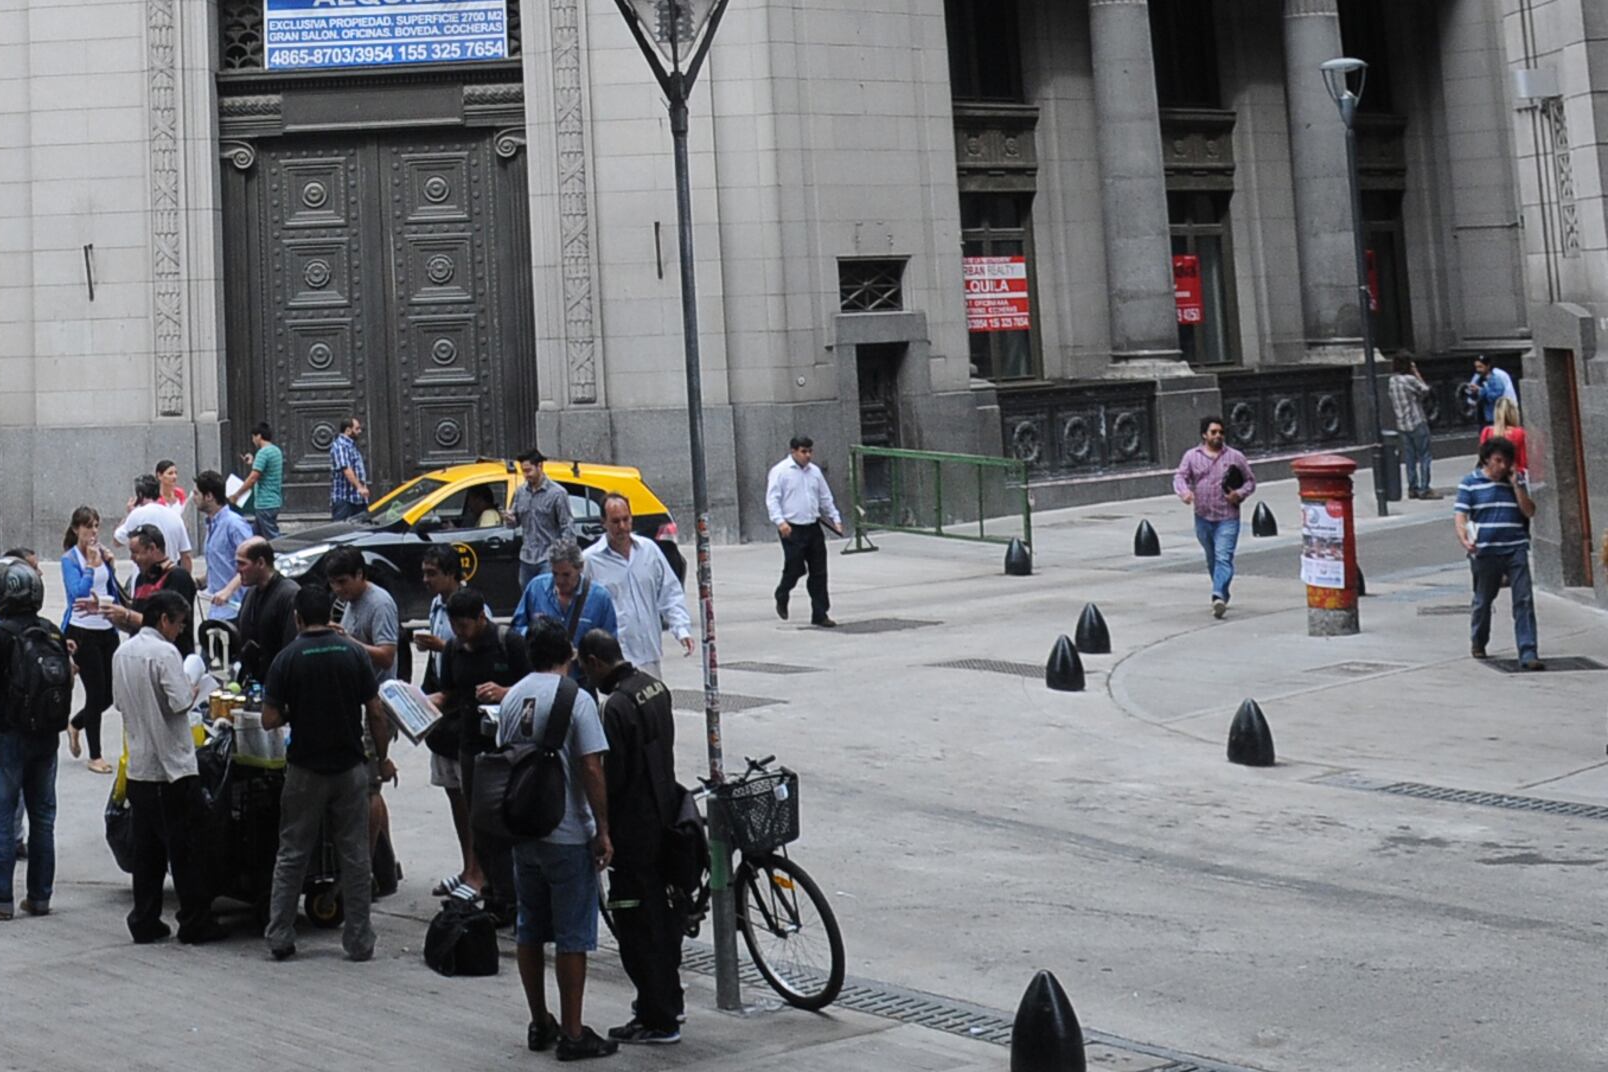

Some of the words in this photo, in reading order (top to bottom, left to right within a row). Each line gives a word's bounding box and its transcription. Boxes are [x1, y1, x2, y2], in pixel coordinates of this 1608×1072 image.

[269, 19, 328, 31] EXCLUSIVA
[396, 13, 459, 25] SUPERFICIE
[487, 11, 503, 21] M2
[269, 31, 299, 42] GRAN
[443, 22, 503, 35] COCHERAS
[270, 45, 394, 66] 4865-8703/3954
[398, 44, 427, 60] 155
[431, 43, 461, 59] 325
[464, 40, 503, 57] 7654
